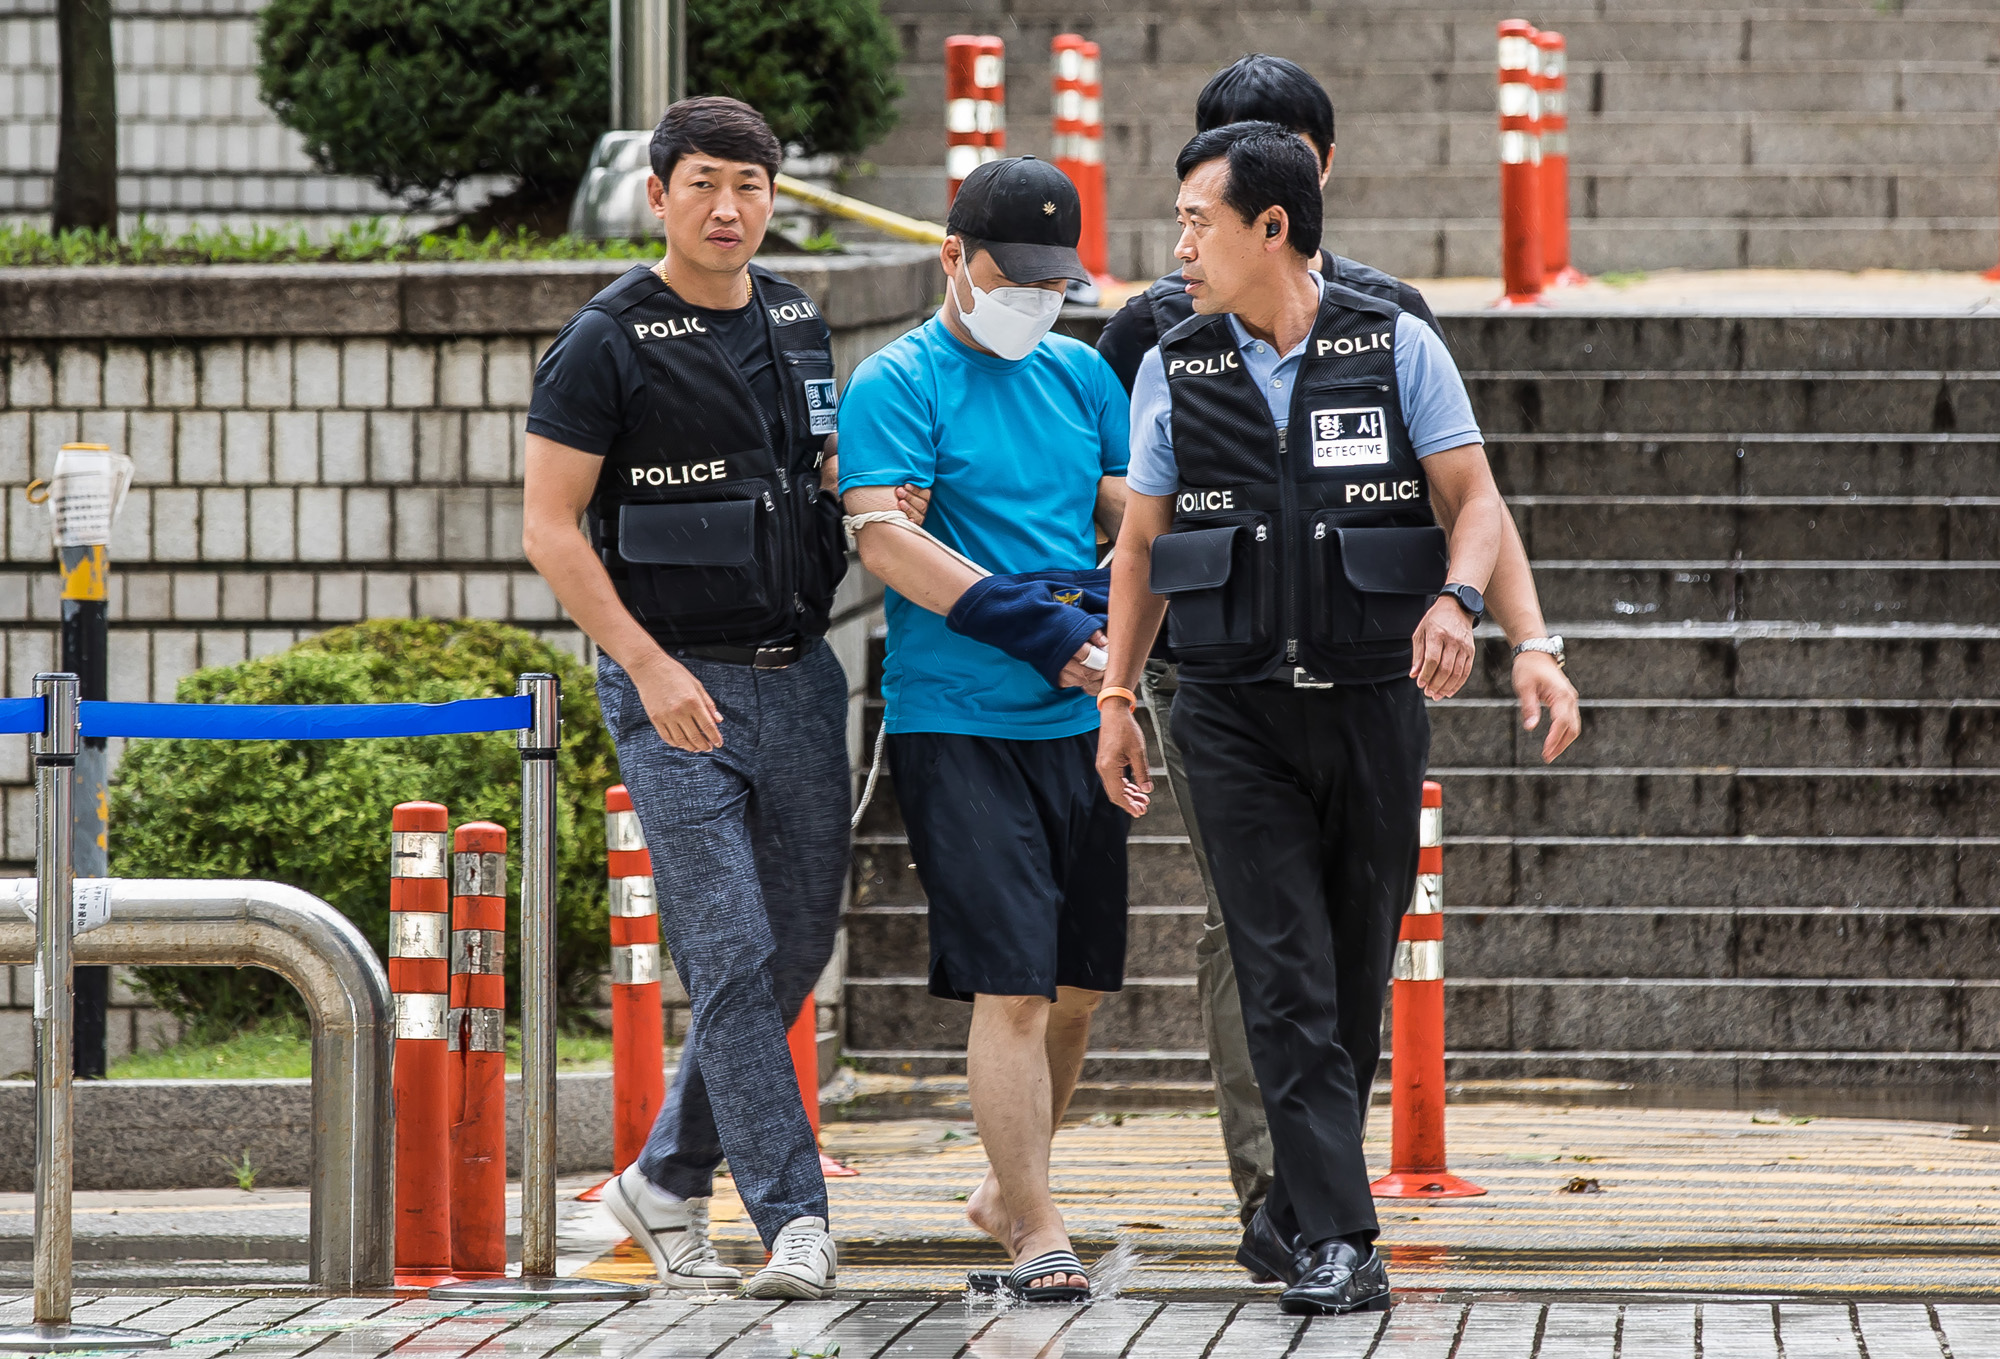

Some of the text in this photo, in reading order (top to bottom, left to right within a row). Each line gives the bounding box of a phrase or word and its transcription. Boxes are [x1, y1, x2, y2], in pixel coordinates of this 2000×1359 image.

[1168, 351, 1239, 375] POLIC
[1317, 444, 1383, 458] DETECTIVE
[631, 460, 727, 486] POLICE
[1176, 490, 1235, 513] POLICE
[1345, 480, 1420, 503] POLICE
